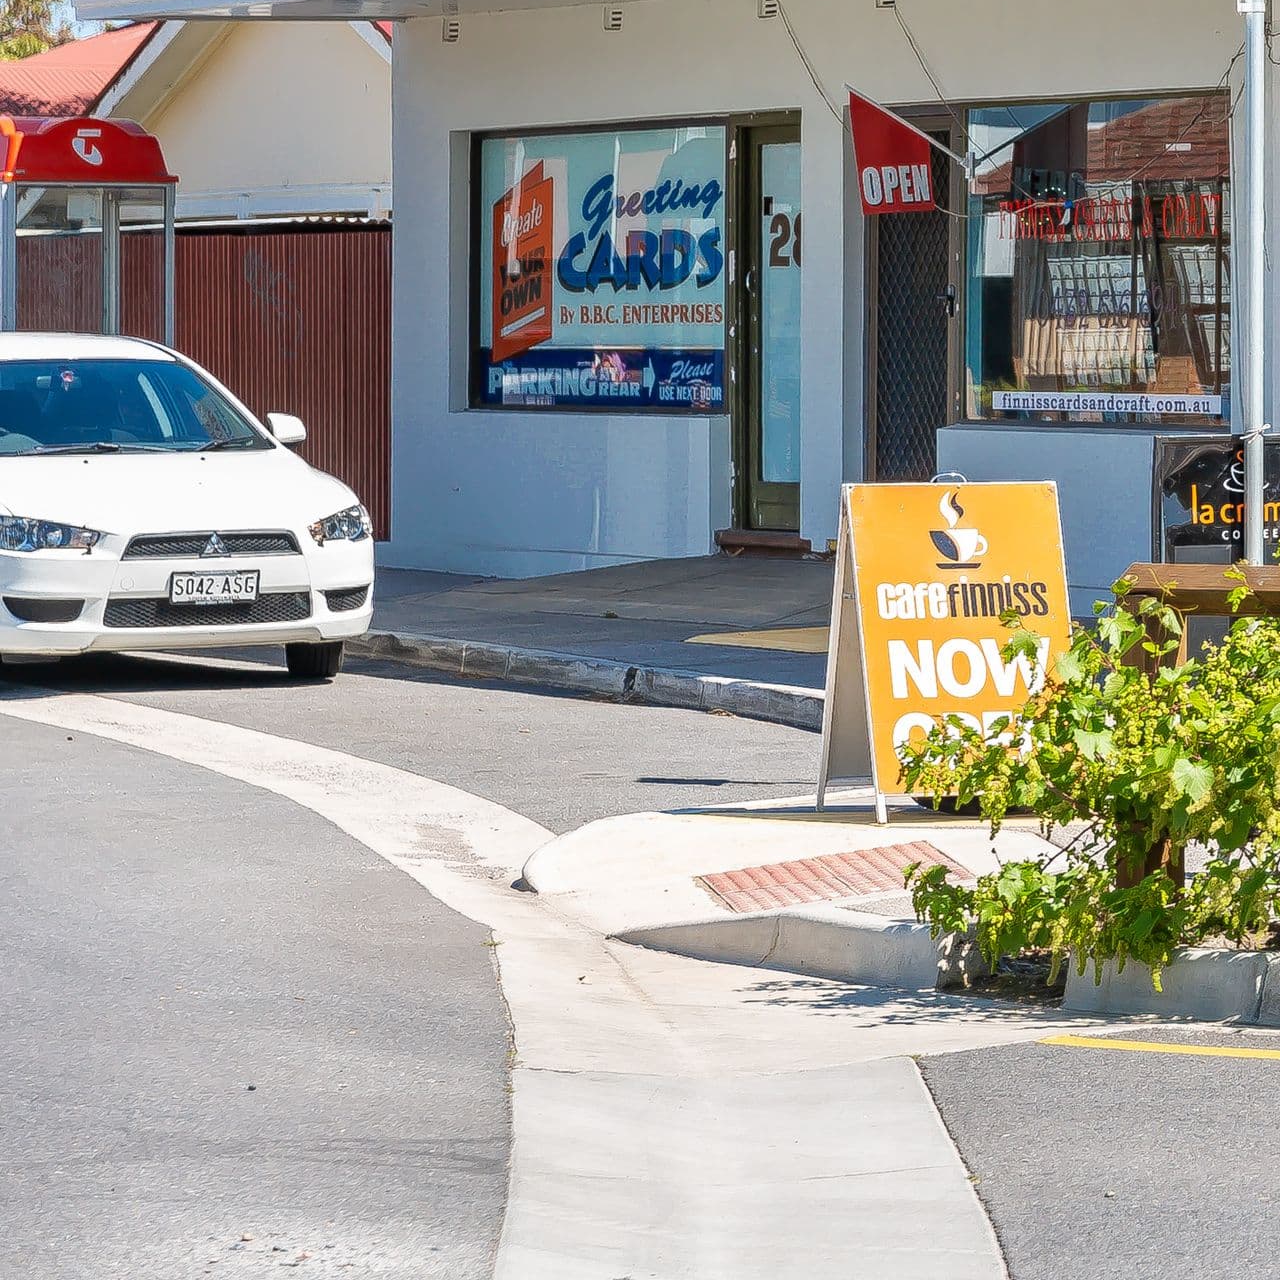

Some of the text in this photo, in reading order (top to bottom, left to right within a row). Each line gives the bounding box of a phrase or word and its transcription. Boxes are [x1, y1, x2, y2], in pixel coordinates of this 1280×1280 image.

[862, 164, 931, 206] OPEN
[501, 197, 543, 248] Create
[582, 173, 724, 241] Greeting
[1161, 191, 1223, 240] CRAFT
[557, 226, 724, 294] CARDS
[501, 274, 543, 317] OWN
[560, 302, 724, 325] By B.B.C. ENTERPRISES
[488, 367, 596, 397] PARKING
[599, 381, 641, 397] REAR
[670, 360, 714, 382] Please
[659, 386, 722, 401] USE NEXT DOOR
[1002, 393, 1210, 413] finnisscardsandcraft.com.au
[1191, 483, 1214, 525] la
[1222, 528, 1279, 541] COEE
[888, 636, 1050, 699] NOW
